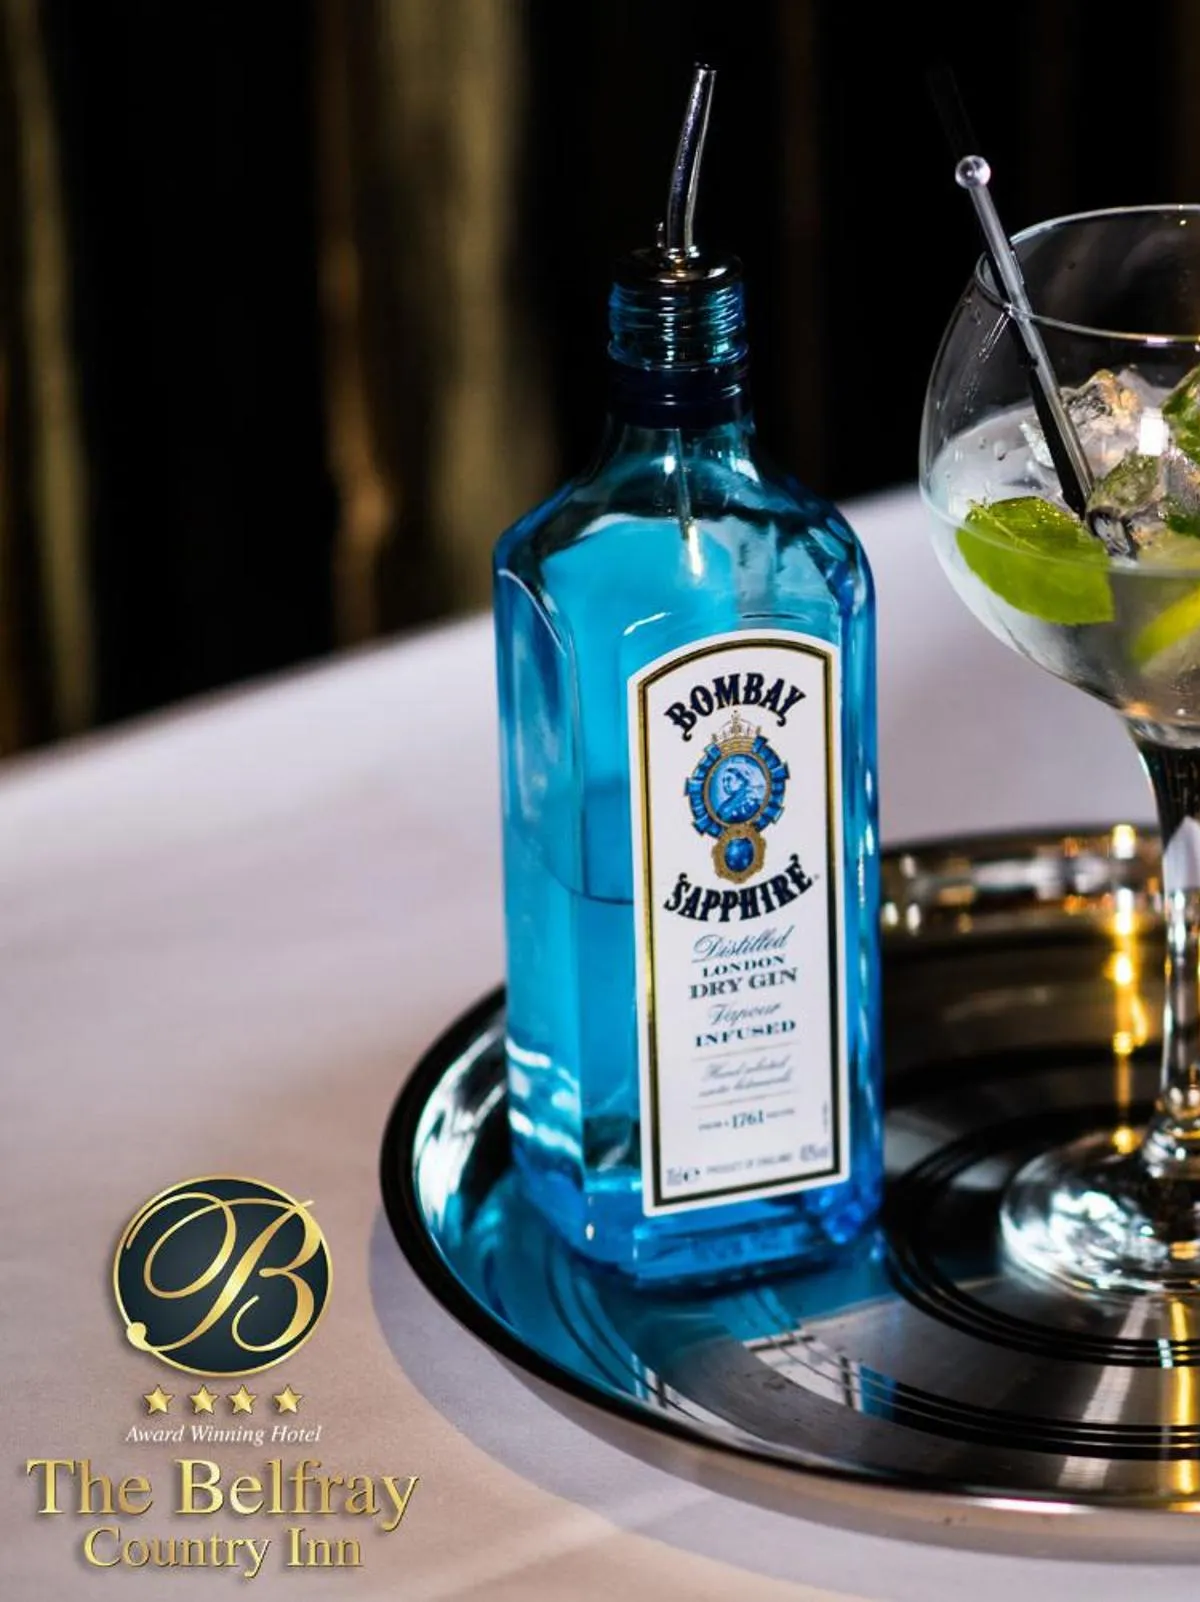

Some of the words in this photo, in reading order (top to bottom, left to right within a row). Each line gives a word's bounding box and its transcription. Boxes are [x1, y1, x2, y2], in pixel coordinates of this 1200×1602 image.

[663, 673, 806, 742] BOMBAY
[663, 853, 813, 922] SAPPHIRE
[691, 925, 795, 963] Distilled
[703, 955, 786, 978] LONDON
[688, 977, 743, 1000] DRY
[749, 967, 799, 990] GIN
[708, 1002, 782, 1026] Vapour
[695, 1020, 797, 1048] INFUSED
[732, 1109, 764, 1129] 1761
